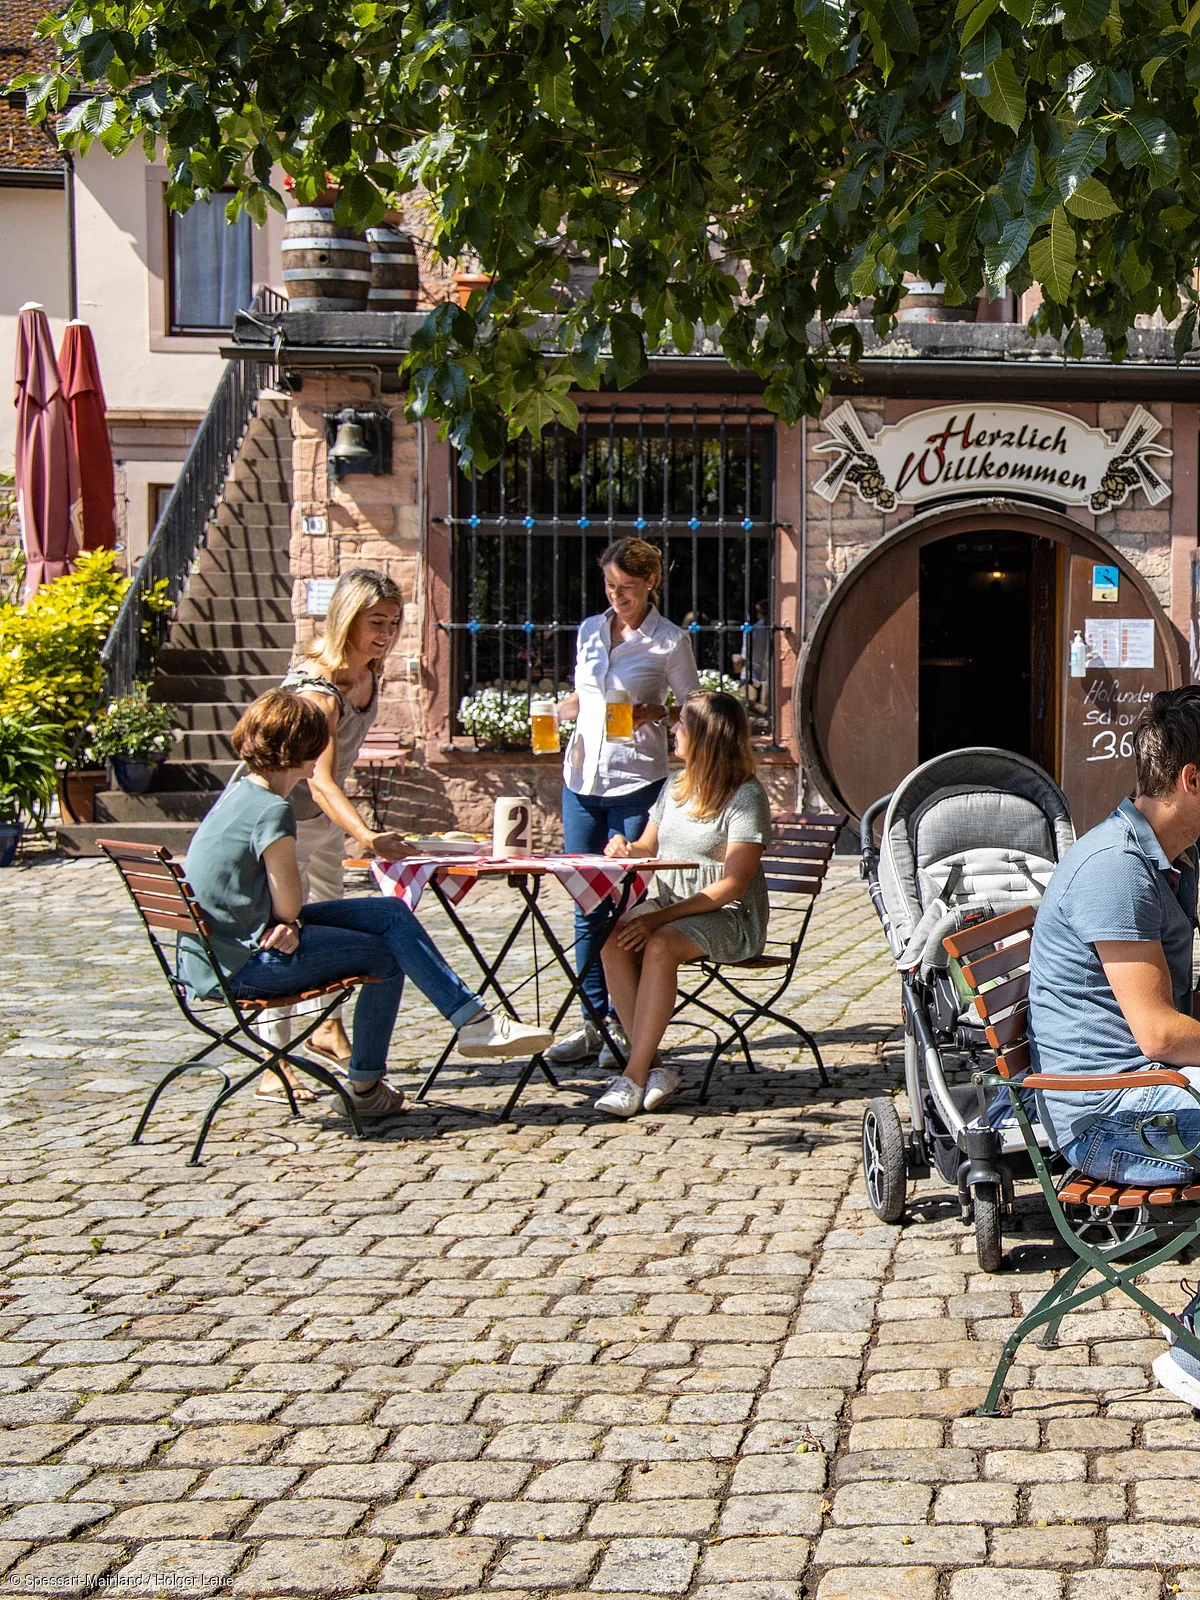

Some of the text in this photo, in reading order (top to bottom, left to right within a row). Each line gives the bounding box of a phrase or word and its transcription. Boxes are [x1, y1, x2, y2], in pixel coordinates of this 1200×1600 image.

[925, 412, 1067, 455] Herzlich
[895, 445, 1088, 493] Willkommen
[1086, 730, 1134, 761] 3.6
[505, 806, 528, 848] 2
